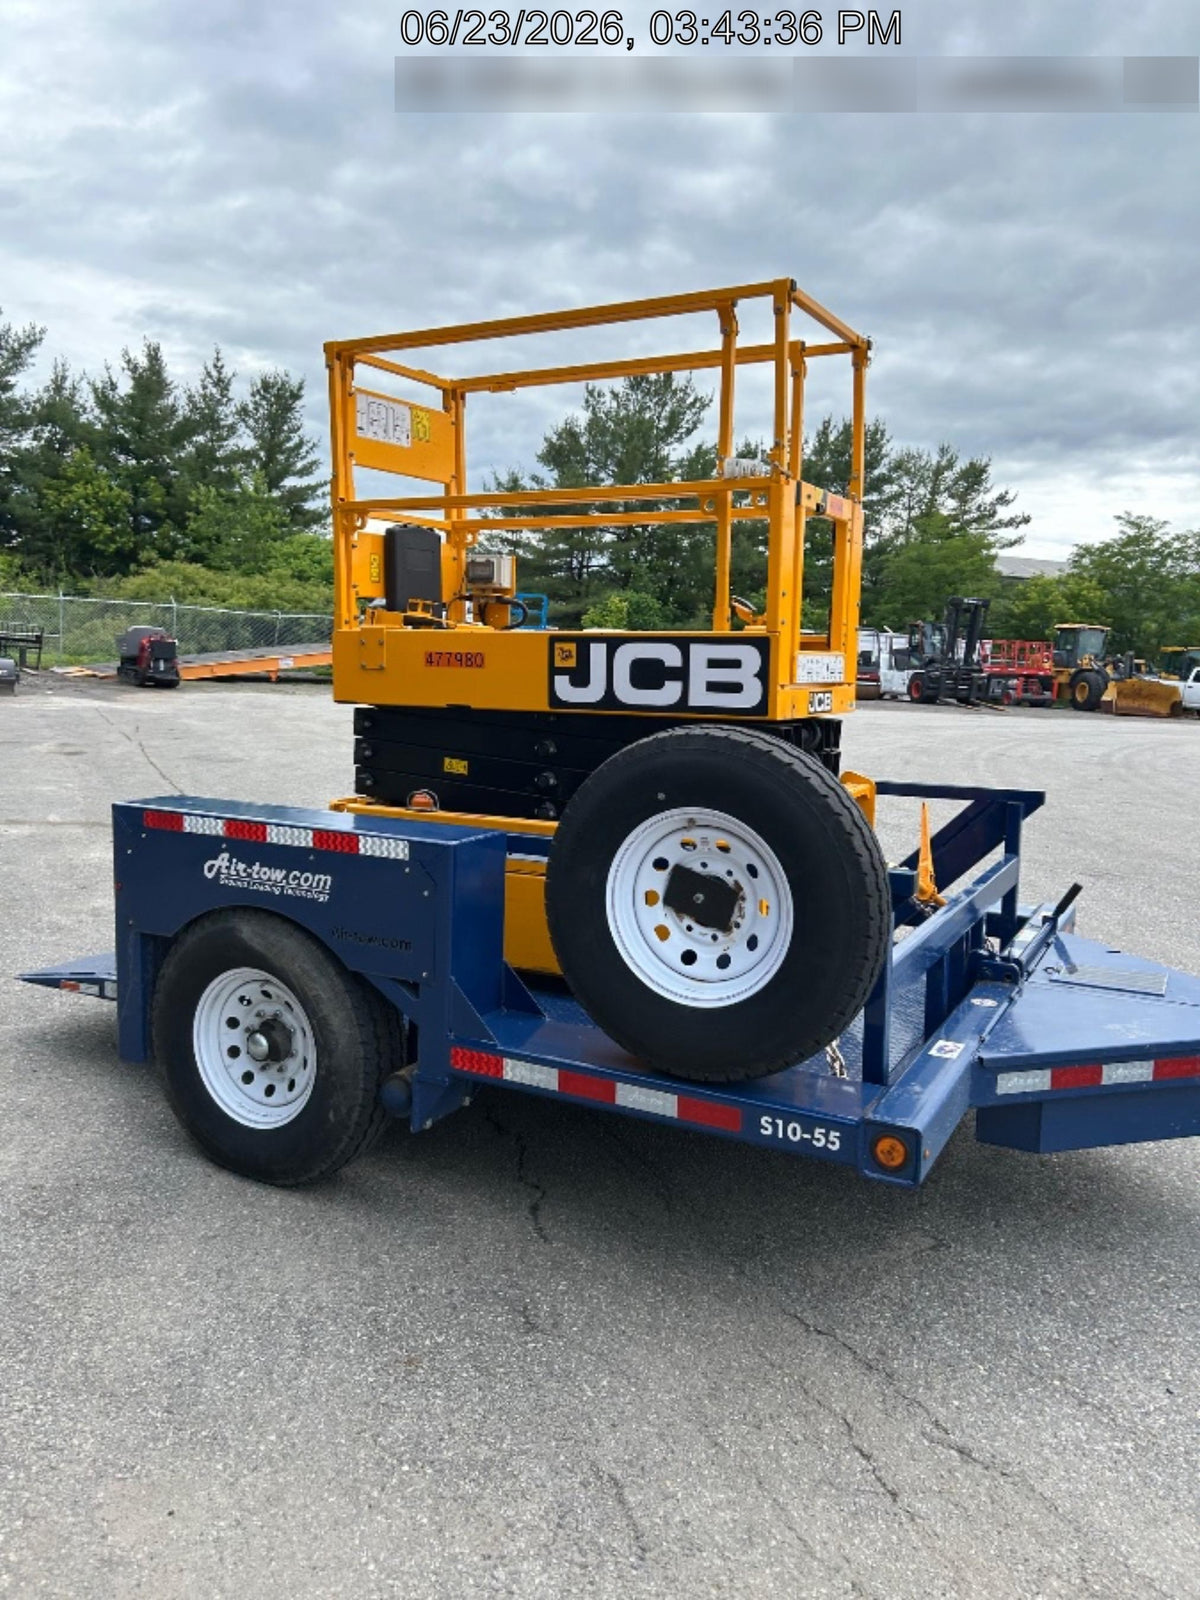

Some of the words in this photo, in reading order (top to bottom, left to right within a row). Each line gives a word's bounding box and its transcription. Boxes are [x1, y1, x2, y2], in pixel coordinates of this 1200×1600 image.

[425, 652, 485, 668] 477980
[554, 642, 763, 709] JCB
[808, 692, 832, 713] JCB
[203, 852, 332, 890] Air-tow.com
[760, 1115, 841, 1152] S10-55
